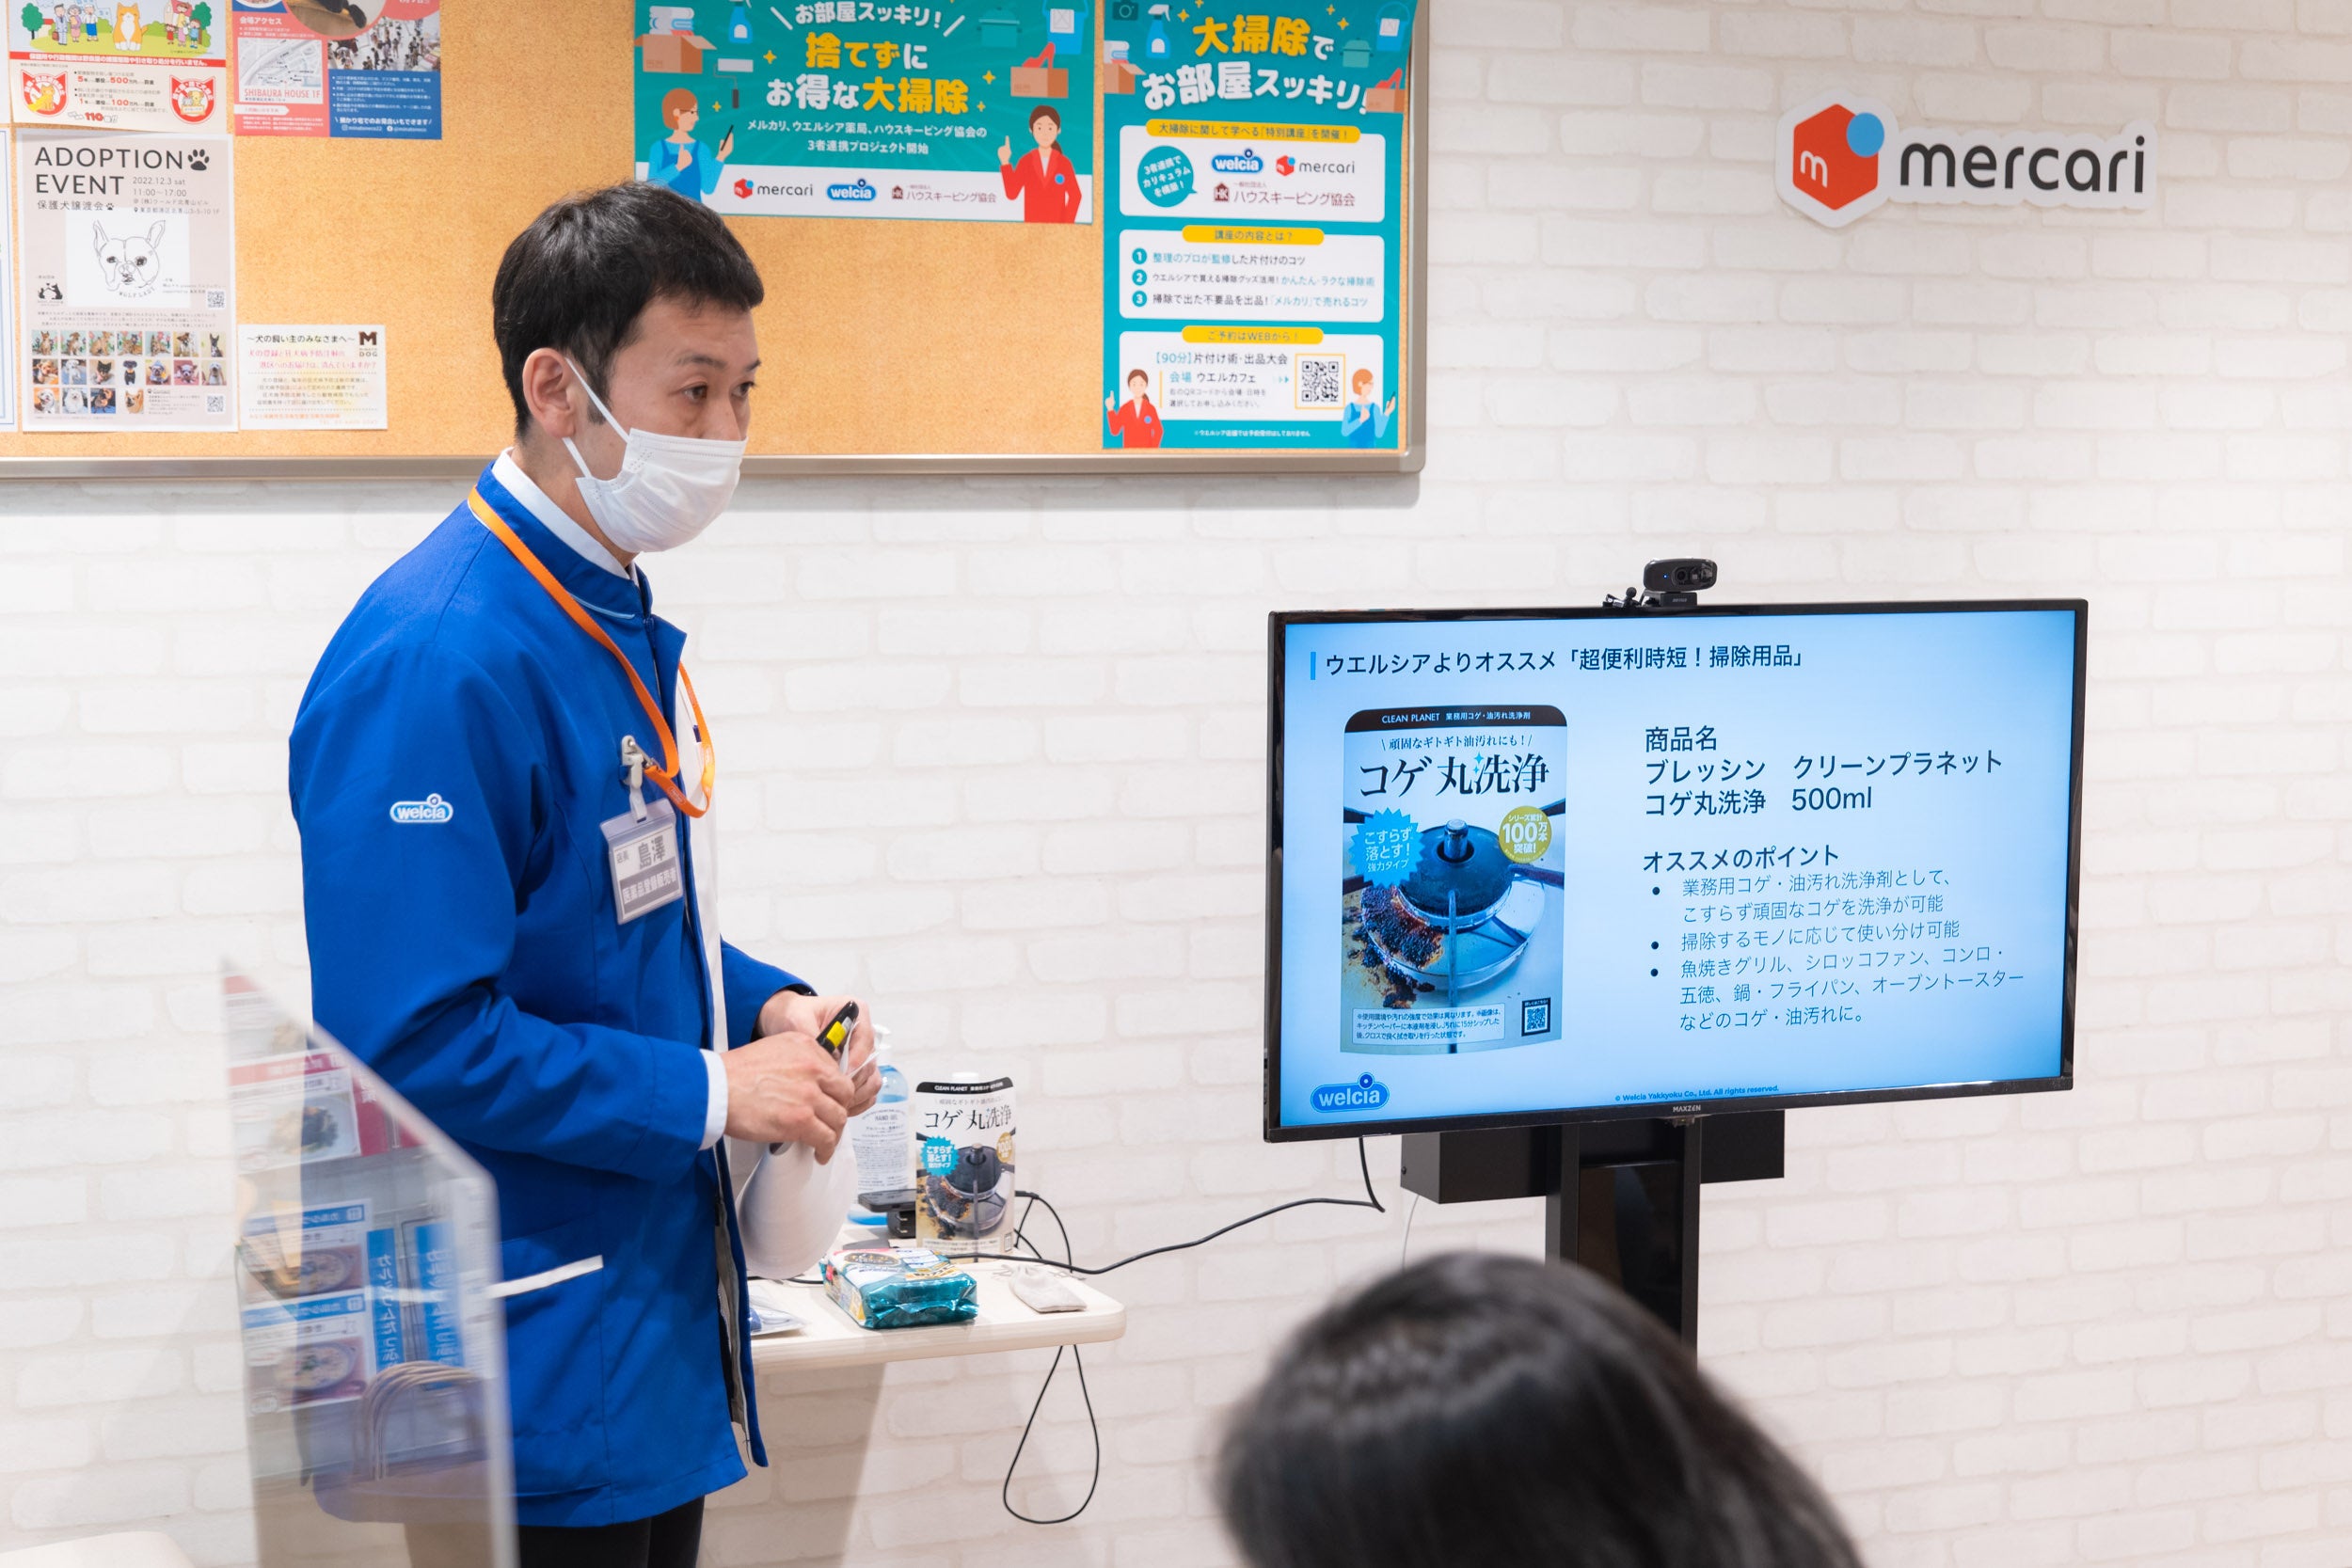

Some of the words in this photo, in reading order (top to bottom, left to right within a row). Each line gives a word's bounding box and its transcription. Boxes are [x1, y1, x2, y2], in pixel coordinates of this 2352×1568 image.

[795, 1, 941, 28] お部屋スッキリ!
[1193, 14, 1334, 61] 大掃除で
[805, 32, 928, 70] 捨てずに
[245, 88, 282, 97] SHIBAURA
[284, 89, 310, 99] HOUSE
[312, 90, 321, 99] 1F
[767, 74, 969, 115] お得な大掃除
[748, 119, 987, 138] メルカリ、ウエルシア薬局、ハウスキーピング協会の
[808, 139, 929, 155] 3者連携プロジェクト開始
[35, 147, 183, 169] ADOPTION
[1215, 156, 1260, 170] welcia
[1299, 161, 1355, 173] mercari
[1900, 135, 2145, 194] mercari
[36, 174, 124, 195] EVENT
[756, 183, 814, 197] mercari
[830, 185, 872, 199] welcia
[38, 199, 103, 211] 保護犬譲渡会
[907, 190, 996, 203] ハウスキーピング協会
[1233, 191, 1355, 207] ハウスキーピング協会
[1152, 252, 1306, 266] 整理のプロが監修した片付けのコツ
[1169, 372, 1192, 383] 会場
[1197, 372, 1256, 383] ウエルカフェ
[1381, 713, 1408, 723] CLEAN
[1411, 712, 1439, 722] PLANET
[1645, 725, 1717, 752] 商品名
[1359, 752, 1549, 798] コゲ丸洗浄
[1646, 758, 1766, 785] ブレッシン
[1794, 750, 2002, 780] クリーンプラネット
[1645, 789, 1766, 816] コゲ丸洗浄
[1792, 786, 1872, 811] 500ml
[397, 802, 446, 820] welcia
[1365, 827, 1411, 845] こすらず
[1366, 844, 1410, 861] 落とす!
[1643, 845, 1839, 873] オススメのポイント
[1368, 859, 1408, 873] 強力タイプ
[1682, 867, 1950, 897] 業務用コゲ・油汚れ洗浄剤として、
[1683, 894, 1944, 924] こすらず頑固なコゲを洗浄が可能
[1681, 920, 1960, 951] 掃除するモノに応じて使い分け可能
[1679, 970, 2024, 1005] 五徳、鍋・フライパン、オーブントースター
[1679, 1005, 1864, 1032] などのコゲ・油汚れに。
[1319, 1087, 1380, 1107] welcia
[1623, 1093, 1646, 1101] Welcia
[1648, 1092, 1683, 1101] Yakkyoku
[1724, 1087, 1746, 1096] rights
[925, 1105, 1011, 1130] コゲ丸洗浄
[1673, 1104, 1701, 1113] MAXZEN
